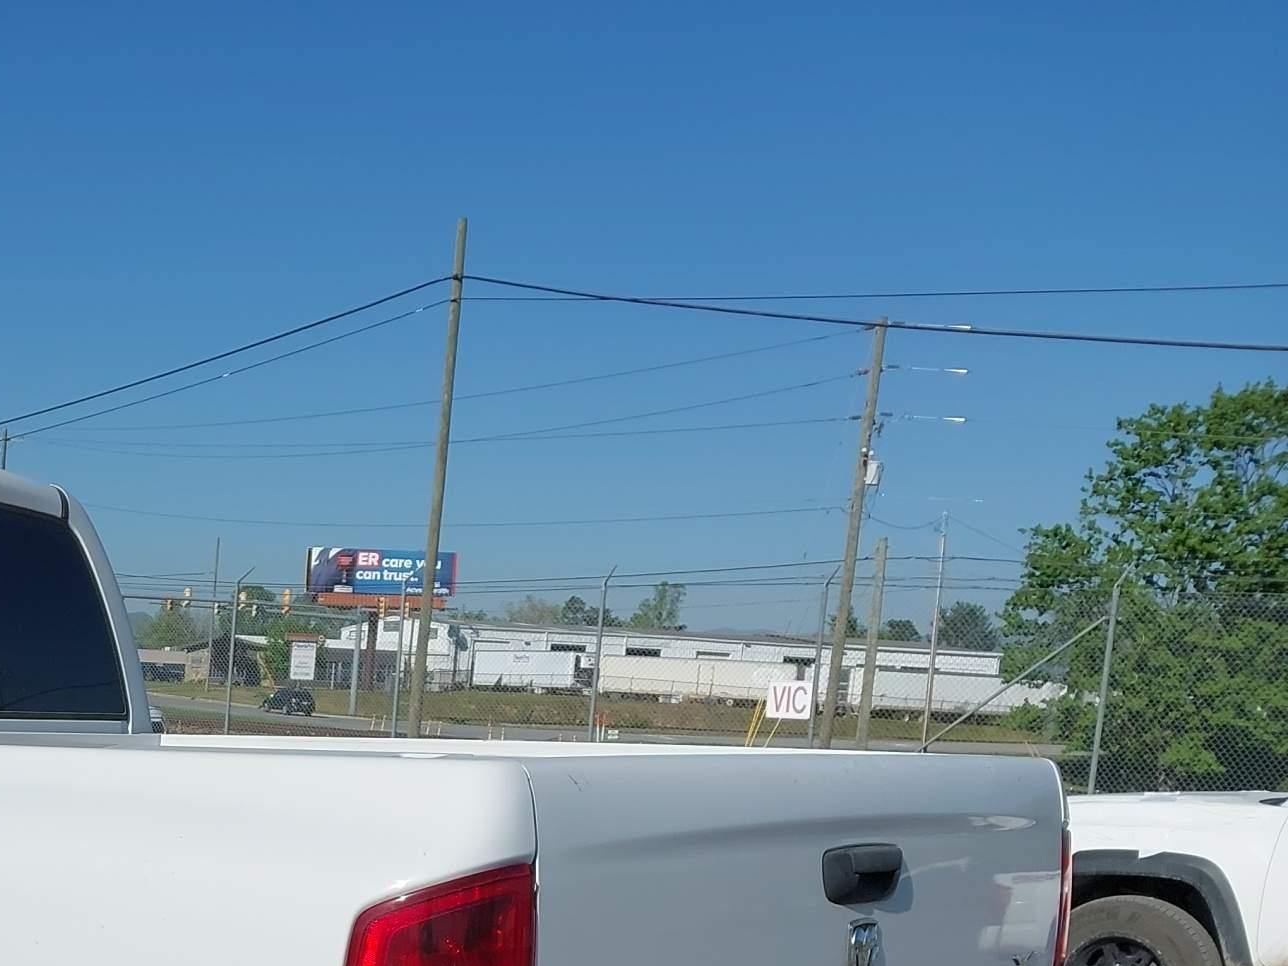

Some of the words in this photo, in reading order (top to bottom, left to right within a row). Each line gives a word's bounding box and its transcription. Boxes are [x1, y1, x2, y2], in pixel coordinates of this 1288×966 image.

[358, 552, 380, 566] ER
[382, 557, 413, 568] care
[416, 559, 442, 571] yu
[355, 570, 381, 580] can
[773, 685, 808, 714] VIC
